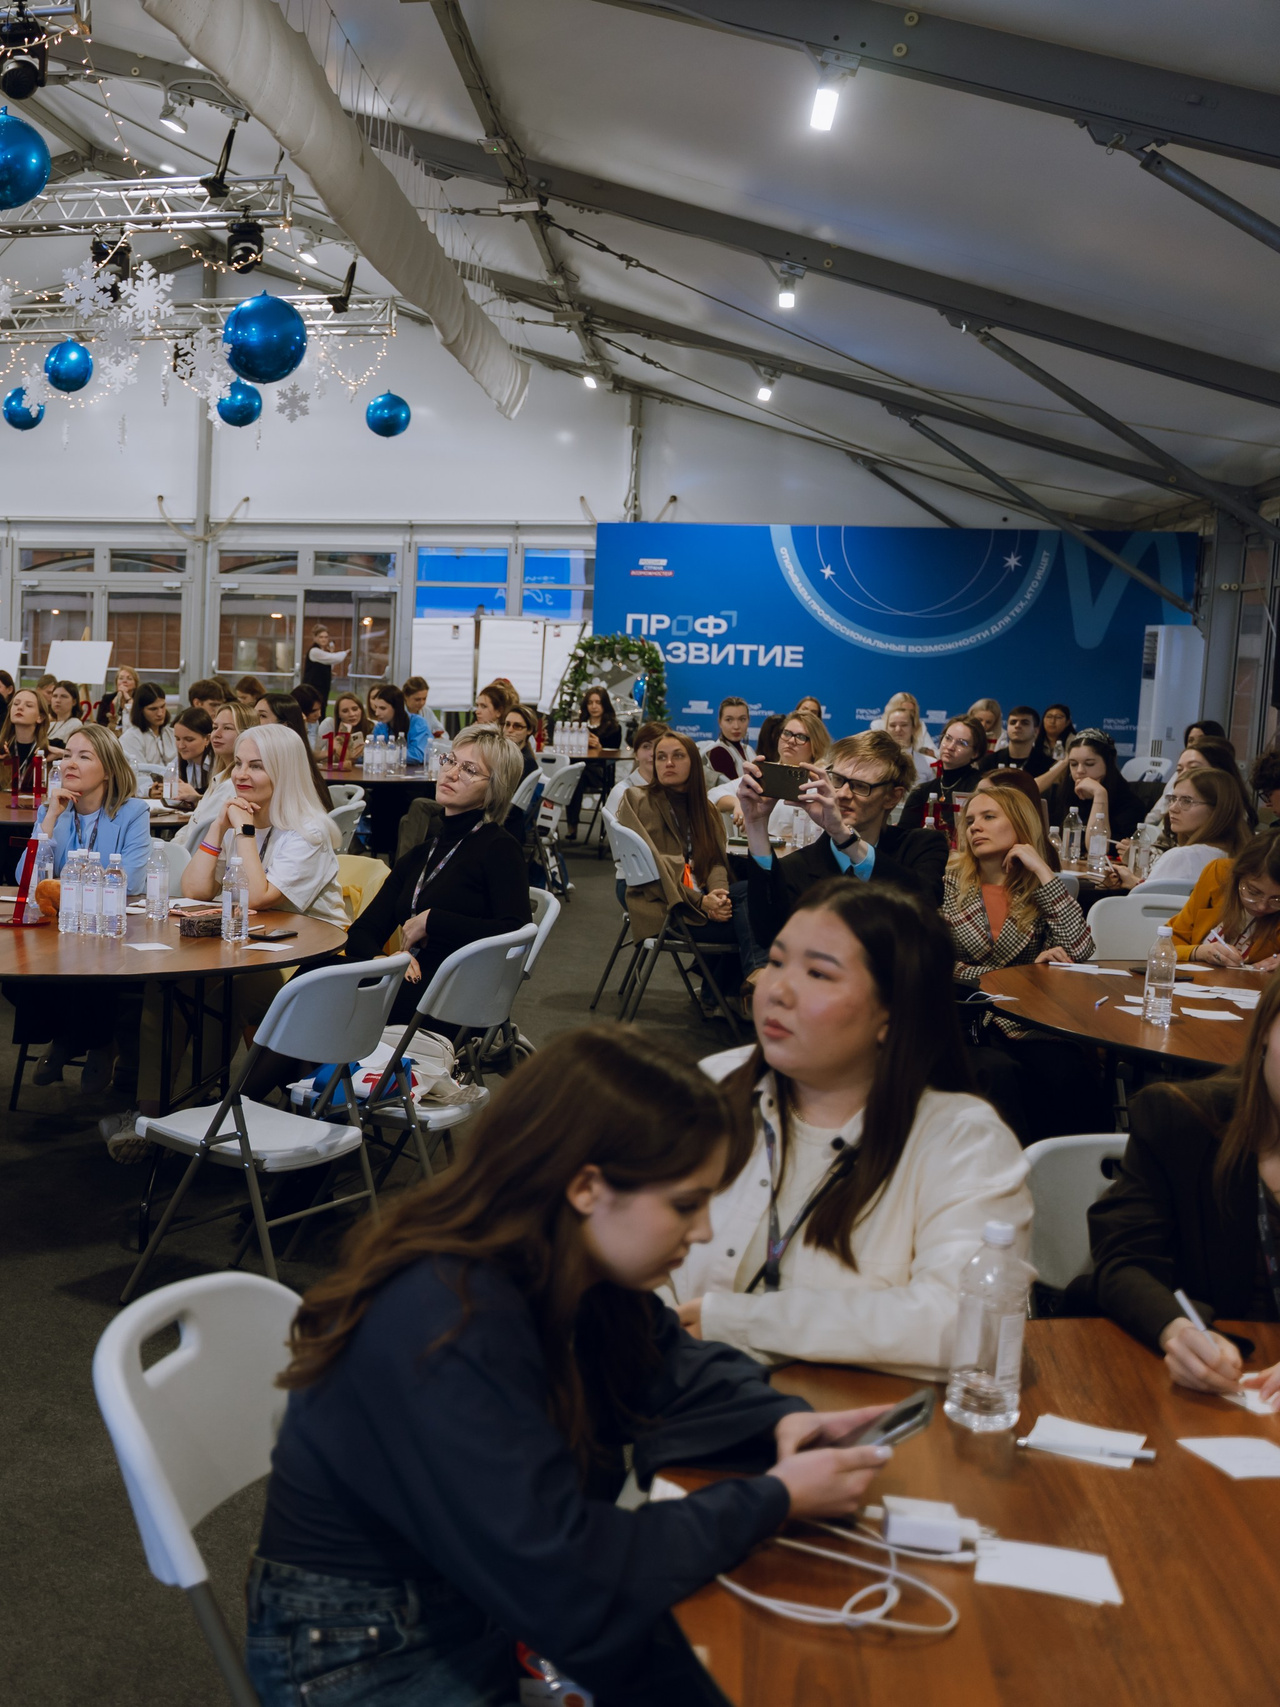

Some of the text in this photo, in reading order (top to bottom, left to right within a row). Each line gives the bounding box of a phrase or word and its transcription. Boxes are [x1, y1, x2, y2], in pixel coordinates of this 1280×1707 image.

[780, 547, 811, 602] ОТКРЫВАЕМ
[808, 600, 907, 653] ПРОФЕССИОНАЛЬНЫЕ
[908, 629, 990, 653] ВОЗМОЖНОСТИ
[990, 615, 1011, 635] ДЛЯ
[1024, 580, 1040, 600] КТО
[1035, 550, 1050, 580] ИЩЕТ
[648, 641, 804, 668] АЗВИТИЕ
[322, 732, 351, 770] 17
